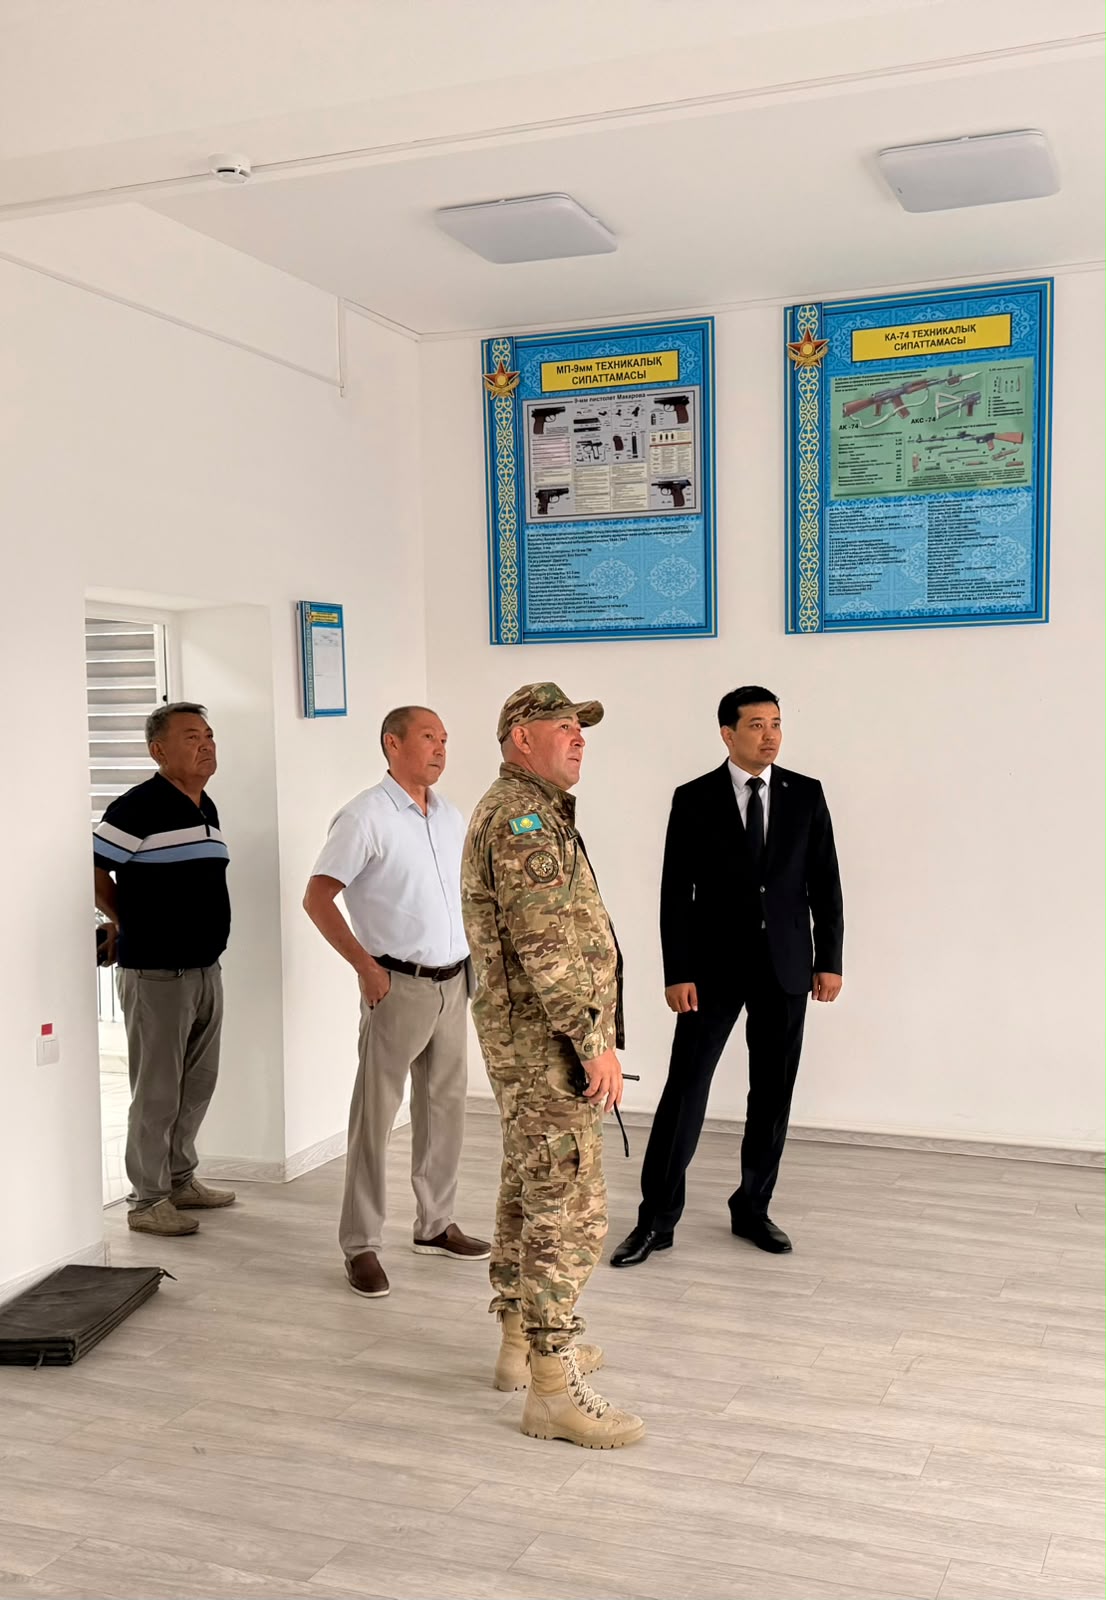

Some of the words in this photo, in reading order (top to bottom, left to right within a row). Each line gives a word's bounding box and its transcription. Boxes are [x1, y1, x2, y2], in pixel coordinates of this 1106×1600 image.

[884, 332, 910, 342] КА-74
[912, 324, 976, 338] ТЕХНИКАЛЫҚ
[894, 336, 966, 350] СИПАТТАМАСЫ
[556, 364, 593, 375] МП-9мм
[595, 356, 662, 371] ТЕХНИКАЛЫҚ
[572, 370, 646, 385] СИПАТТАМАСЫ
